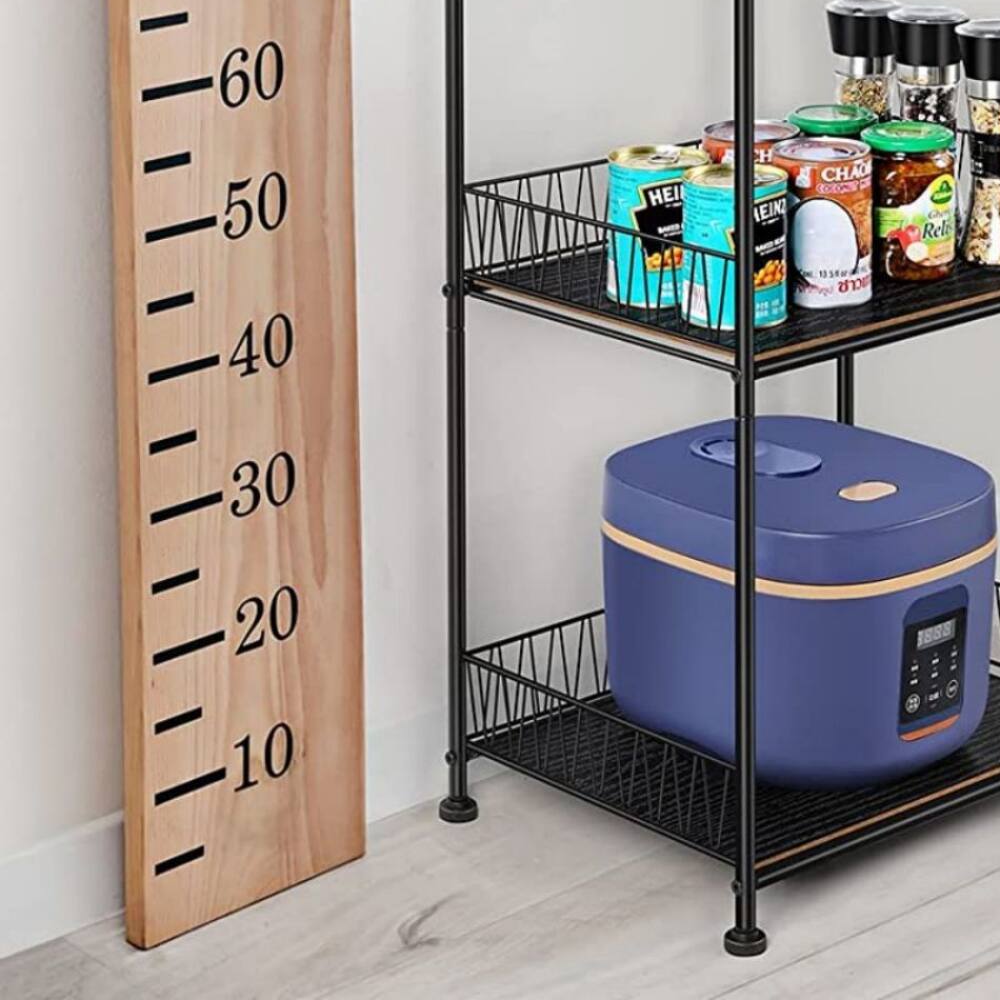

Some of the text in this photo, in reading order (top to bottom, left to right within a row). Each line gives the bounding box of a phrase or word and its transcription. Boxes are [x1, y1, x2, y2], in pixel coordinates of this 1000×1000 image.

[220, 41, 284, 108] 60
[223, 171, 287, 240] 50
[228, 313, 293, 377] 40
[230, 451, 295, 518] 30
[234, 585, 299, 656] 20
[233, 722, 294, 792] 10
